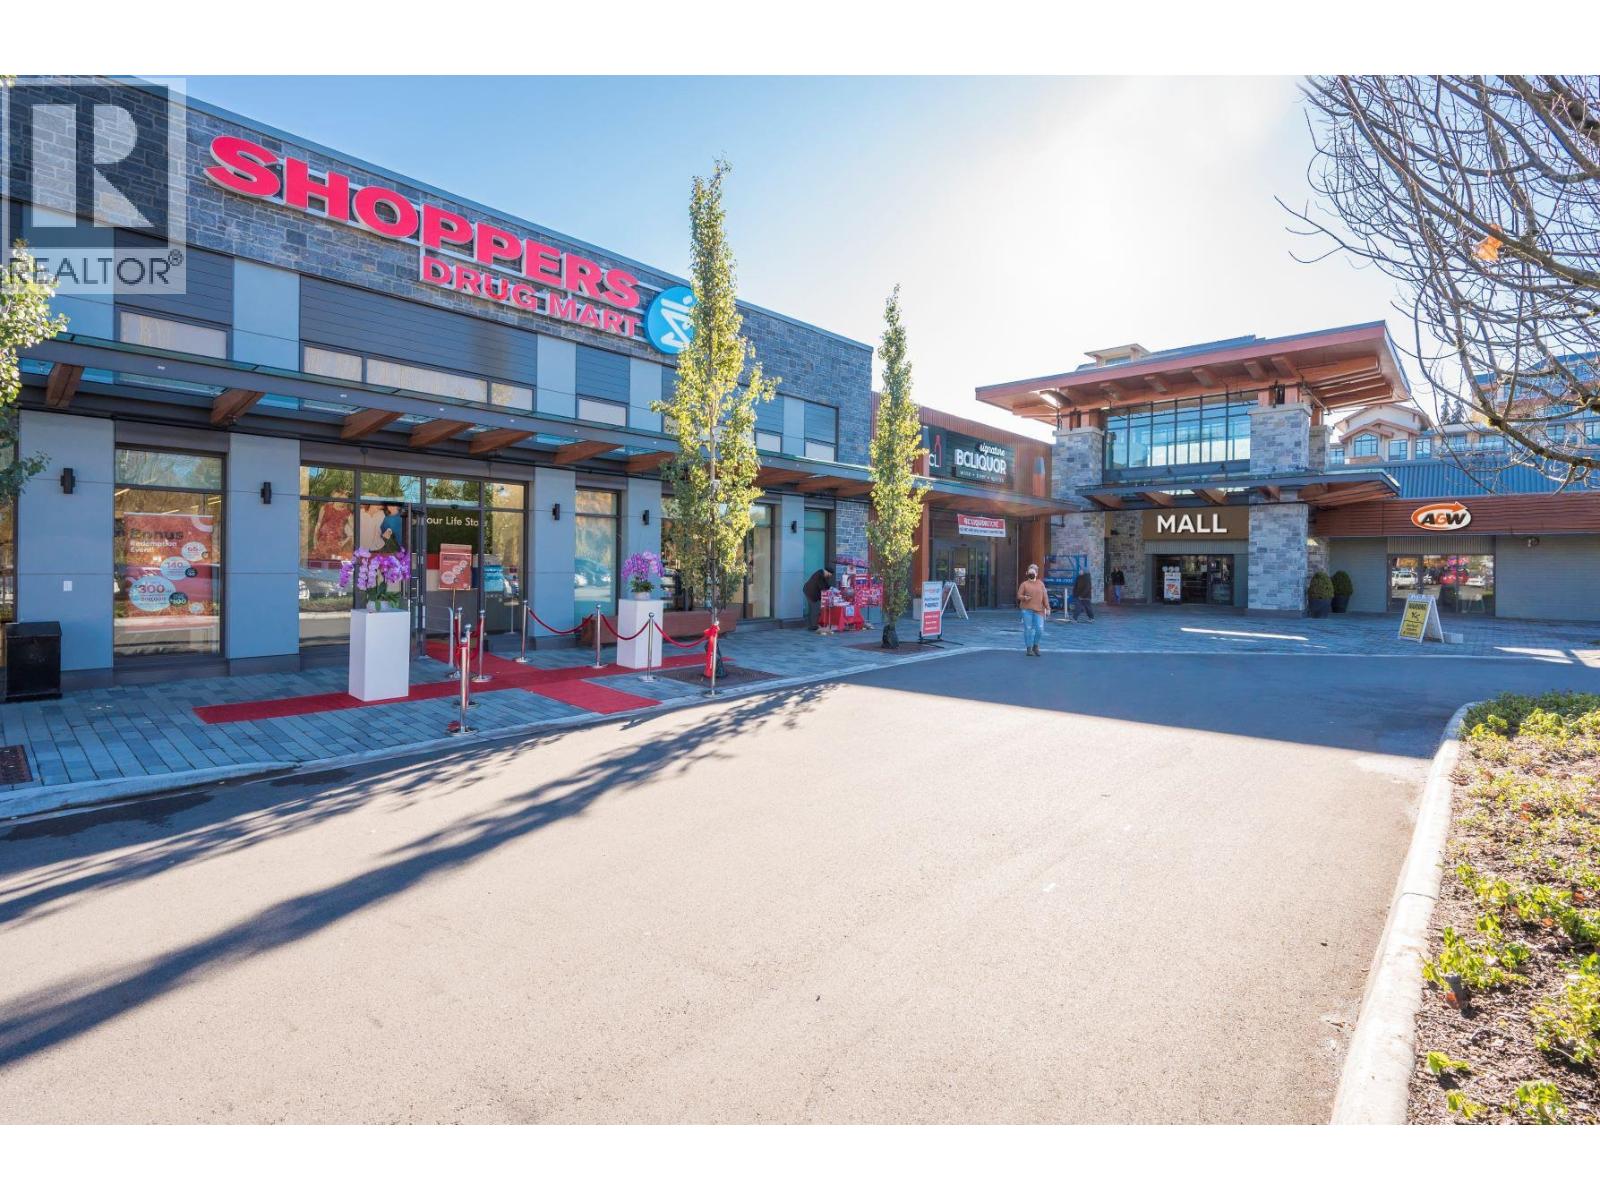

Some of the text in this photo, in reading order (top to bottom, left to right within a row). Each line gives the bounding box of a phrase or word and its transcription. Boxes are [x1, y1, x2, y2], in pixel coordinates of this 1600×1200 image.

[204, 135, 640, 309] SHOPPERS
[421, 255, 640, 338] DRUG MART
[954, 448, 1007, 475] BCLIQUOR
[445, 516, 462, 526] Life
[1157, 513, 1228, 534] MALL
[1420, 512, 1467, 526] A&W
